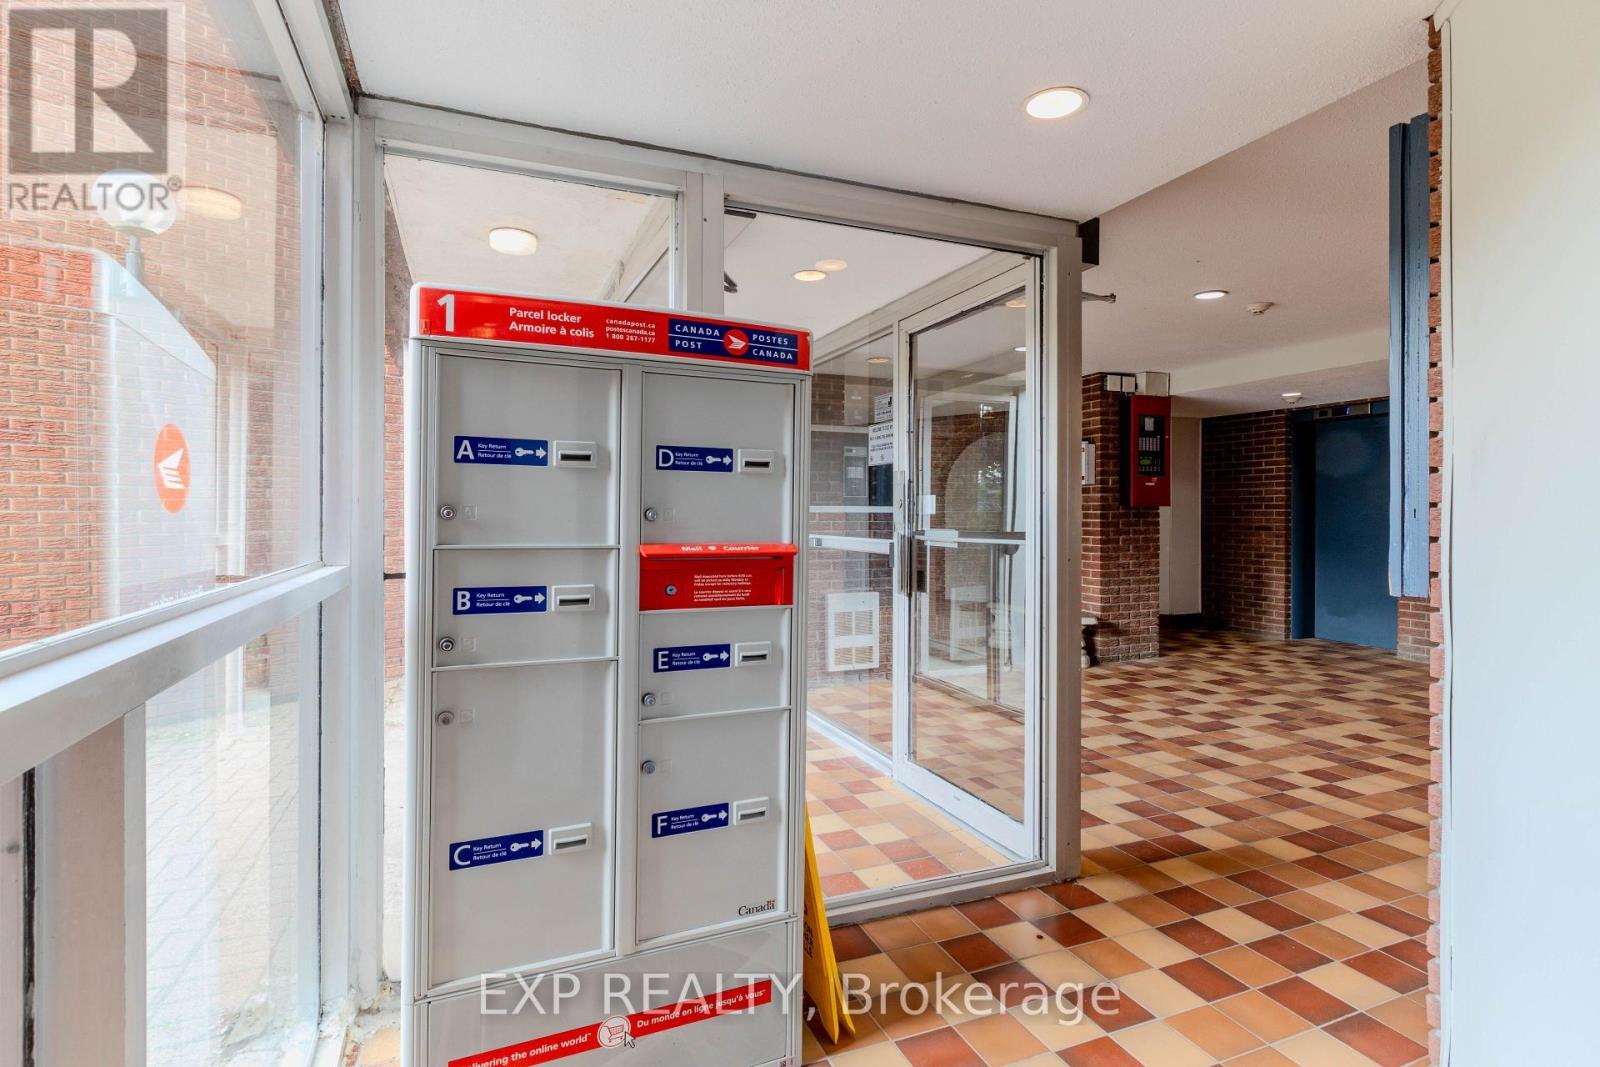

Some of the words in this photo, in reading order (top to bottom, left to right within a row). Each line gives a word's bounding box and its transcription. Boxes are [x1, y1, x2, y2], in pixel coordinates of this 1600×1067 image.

[437, 293, 454, 332] 1
[508, 307, 544, 320] Parcel
[547, 311, 582, 324] locker
[508, 321, 557, 334] Armoire
[559, 326, 567, 336] à
[569, 327, 595, 339] colis
[605, 318, 656, 329] canadapost.ca
[605, 326, 656, 336] postescanada.ca
[674, 324, 720, 337] CANADA
[674, 339, 703, 350] POST
[752, 333, 789, 346] POSTES
[752, 348, 794, 360] CANADA
[456, 439, 475, 460] A
[658, 449, 675, 467] D
[456, 590, 471, 611] B
[658, 650, 669, 670] E
[657, 815, 668, 835] F
[453, 844, 471, 866] C
[738, 899, 775, 916] Canada
[637, 1019, 649, 1028] Du
[651, 1011, 680, 1024] monde
[681, 1008, 692, 1016] en
[511, 1051, 528, 1062] the
[529, 1042, 559, 1057] online
